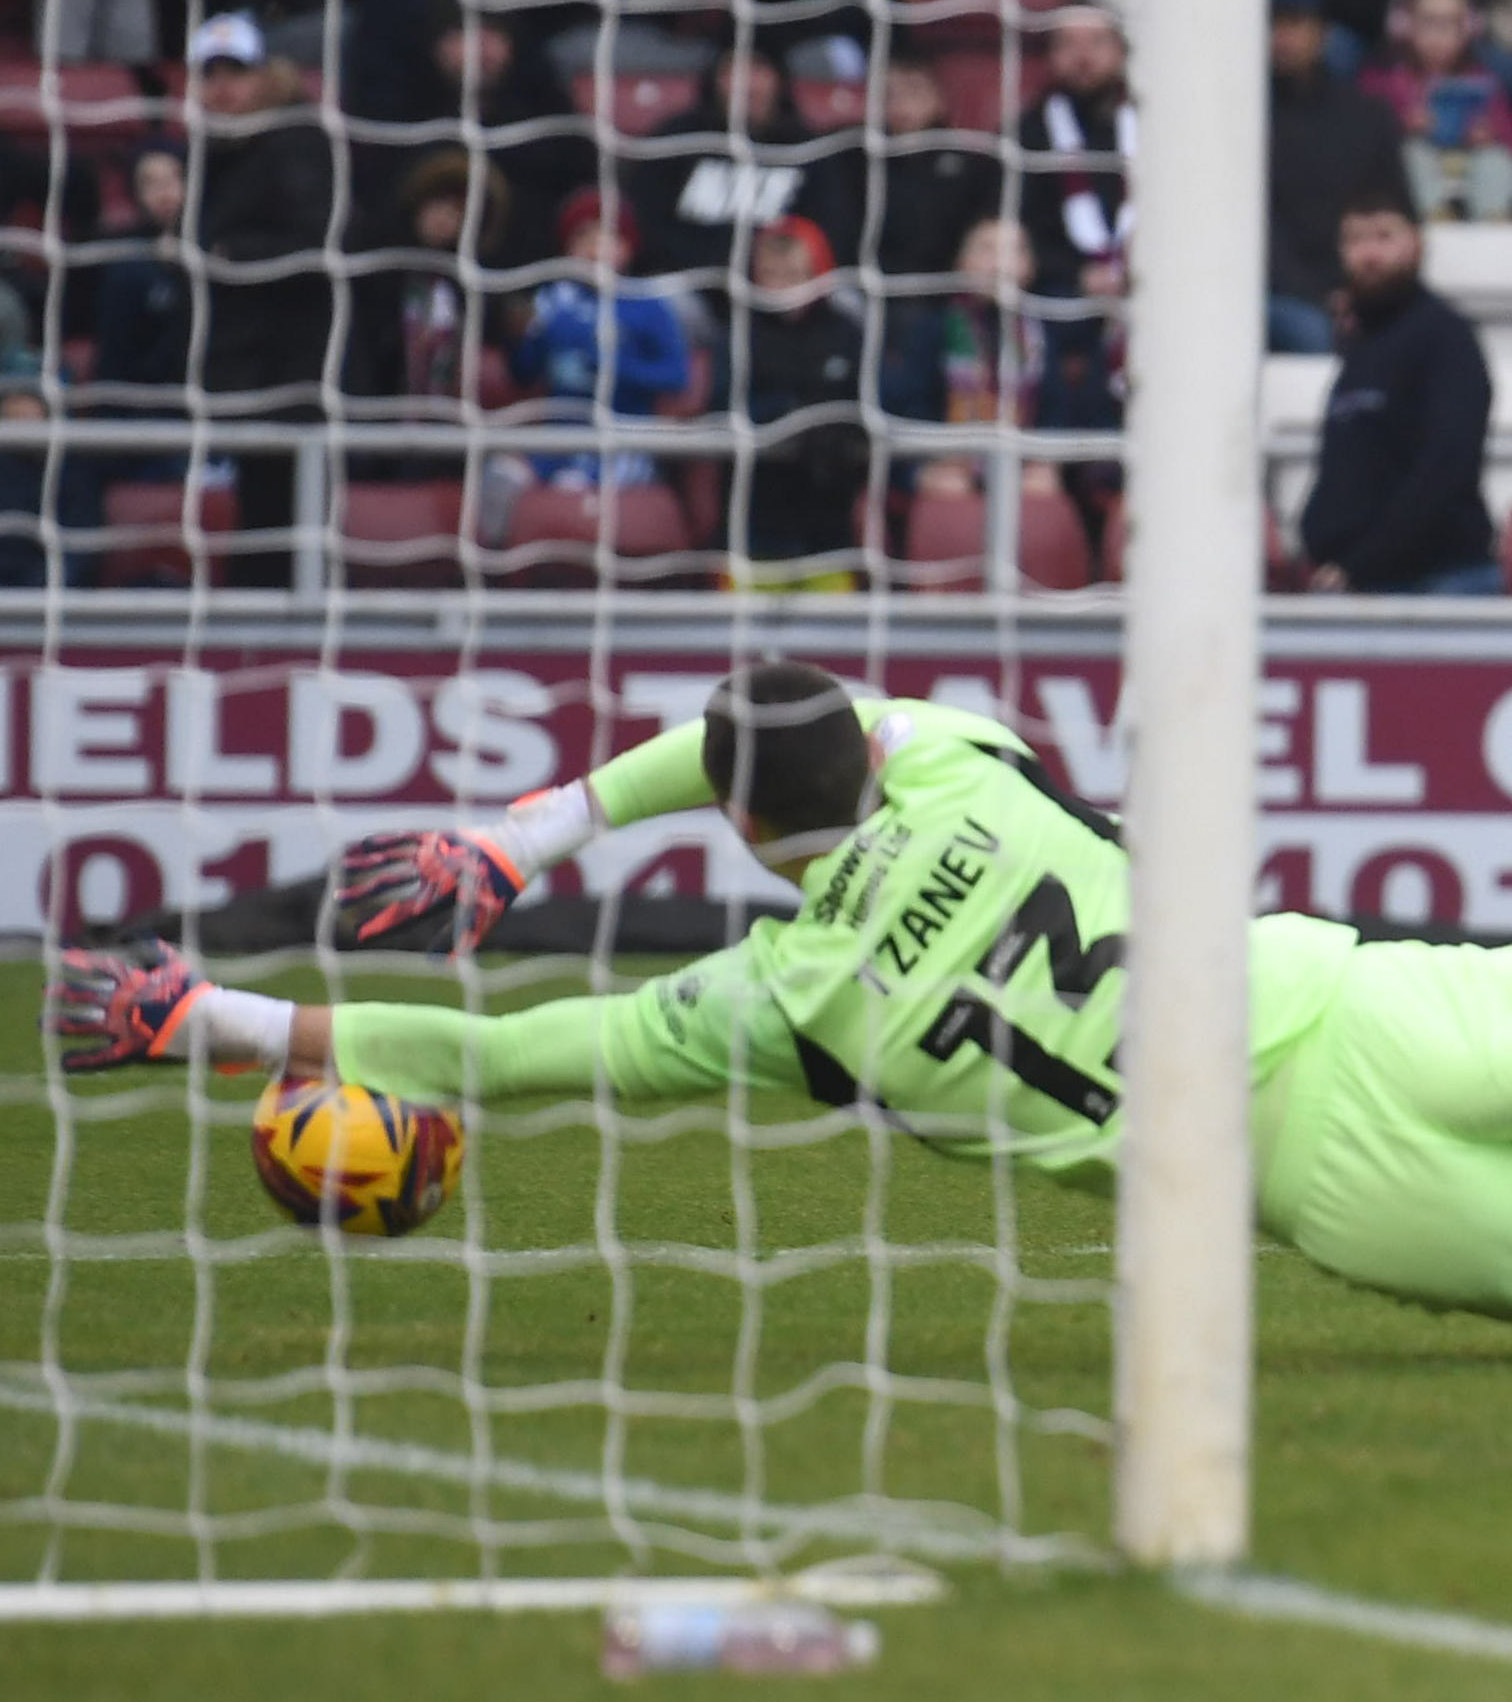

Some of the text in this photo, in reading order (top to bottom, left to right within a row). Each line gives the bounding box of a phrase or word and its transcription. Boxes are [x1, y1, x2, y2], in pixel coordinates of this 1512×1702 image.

[0, 666, 560, 800] ELDS
[853, 816, 999, 996] TZANEV
[918, 871, 1130, 1127] 13
